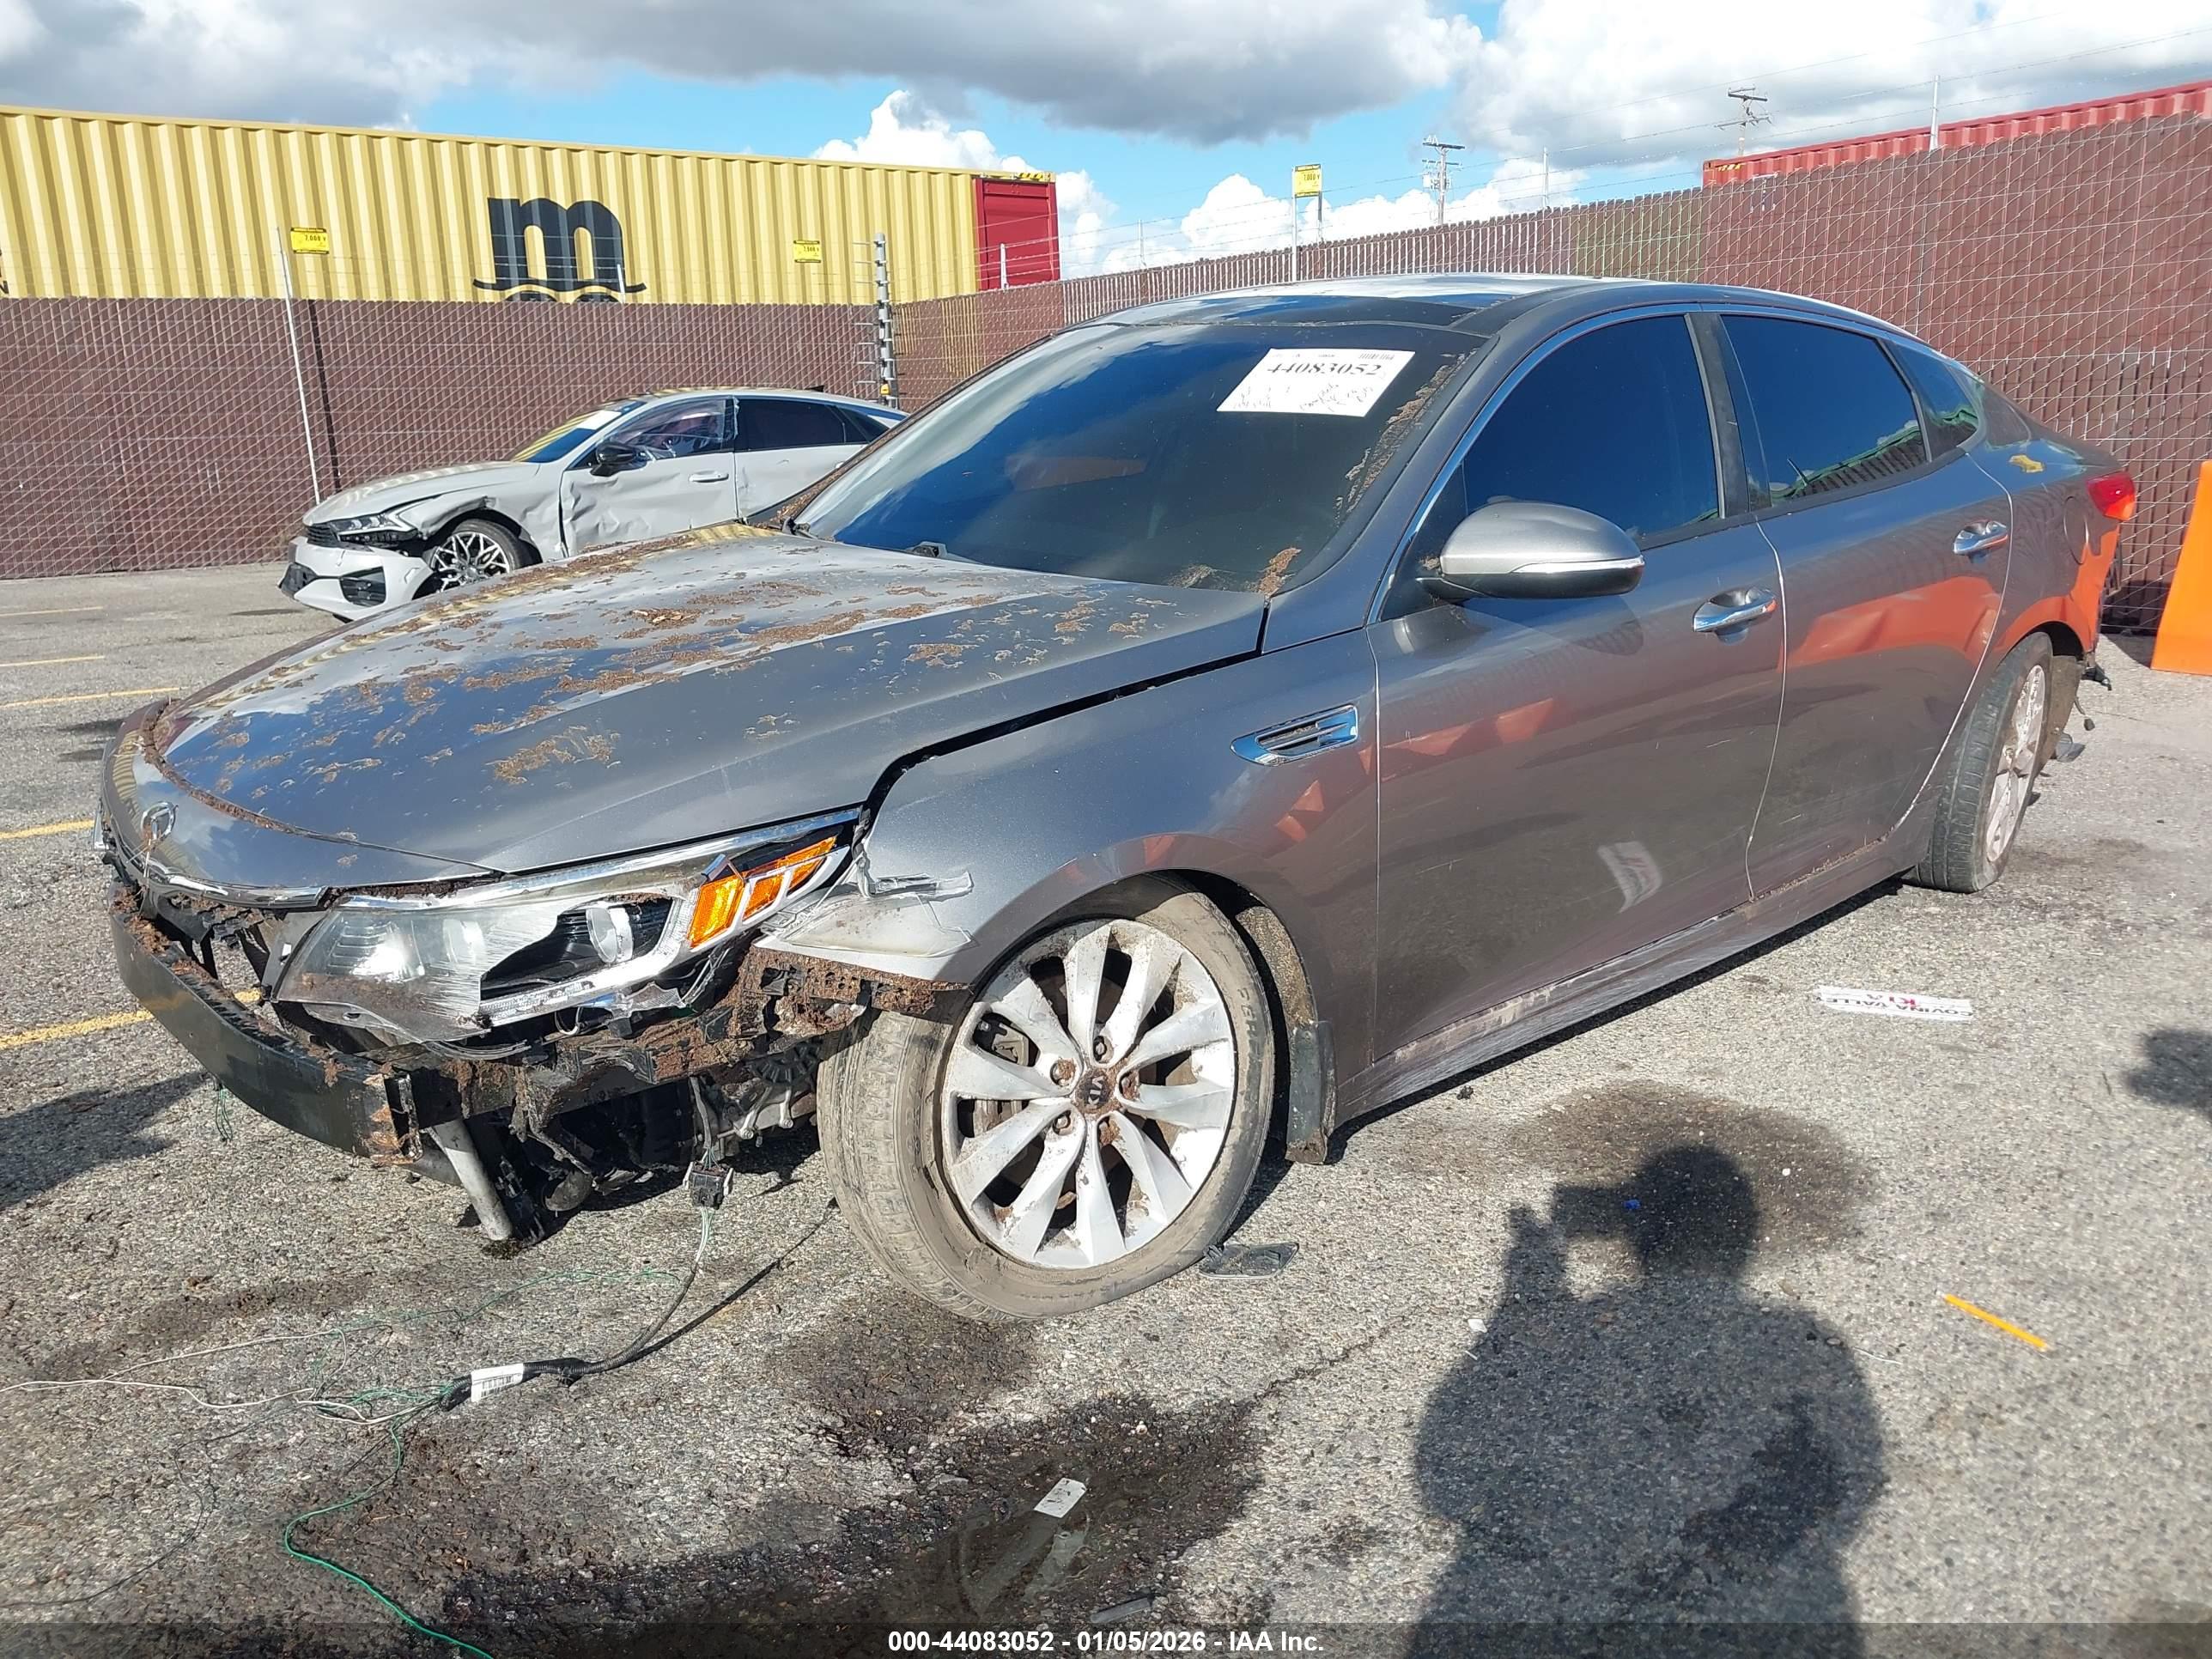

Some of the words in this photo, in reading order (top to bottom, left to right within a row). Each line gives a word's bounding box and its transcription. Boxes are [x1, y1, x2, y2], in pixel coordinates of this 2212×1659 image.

[1267, 362, 1382, 375] 44083052
[1816, 996, 1887, 1007] VALLEY
[1867, 994, 1916, 1005] KIA
[1896, 1005, 1973, 1016] COVINA
